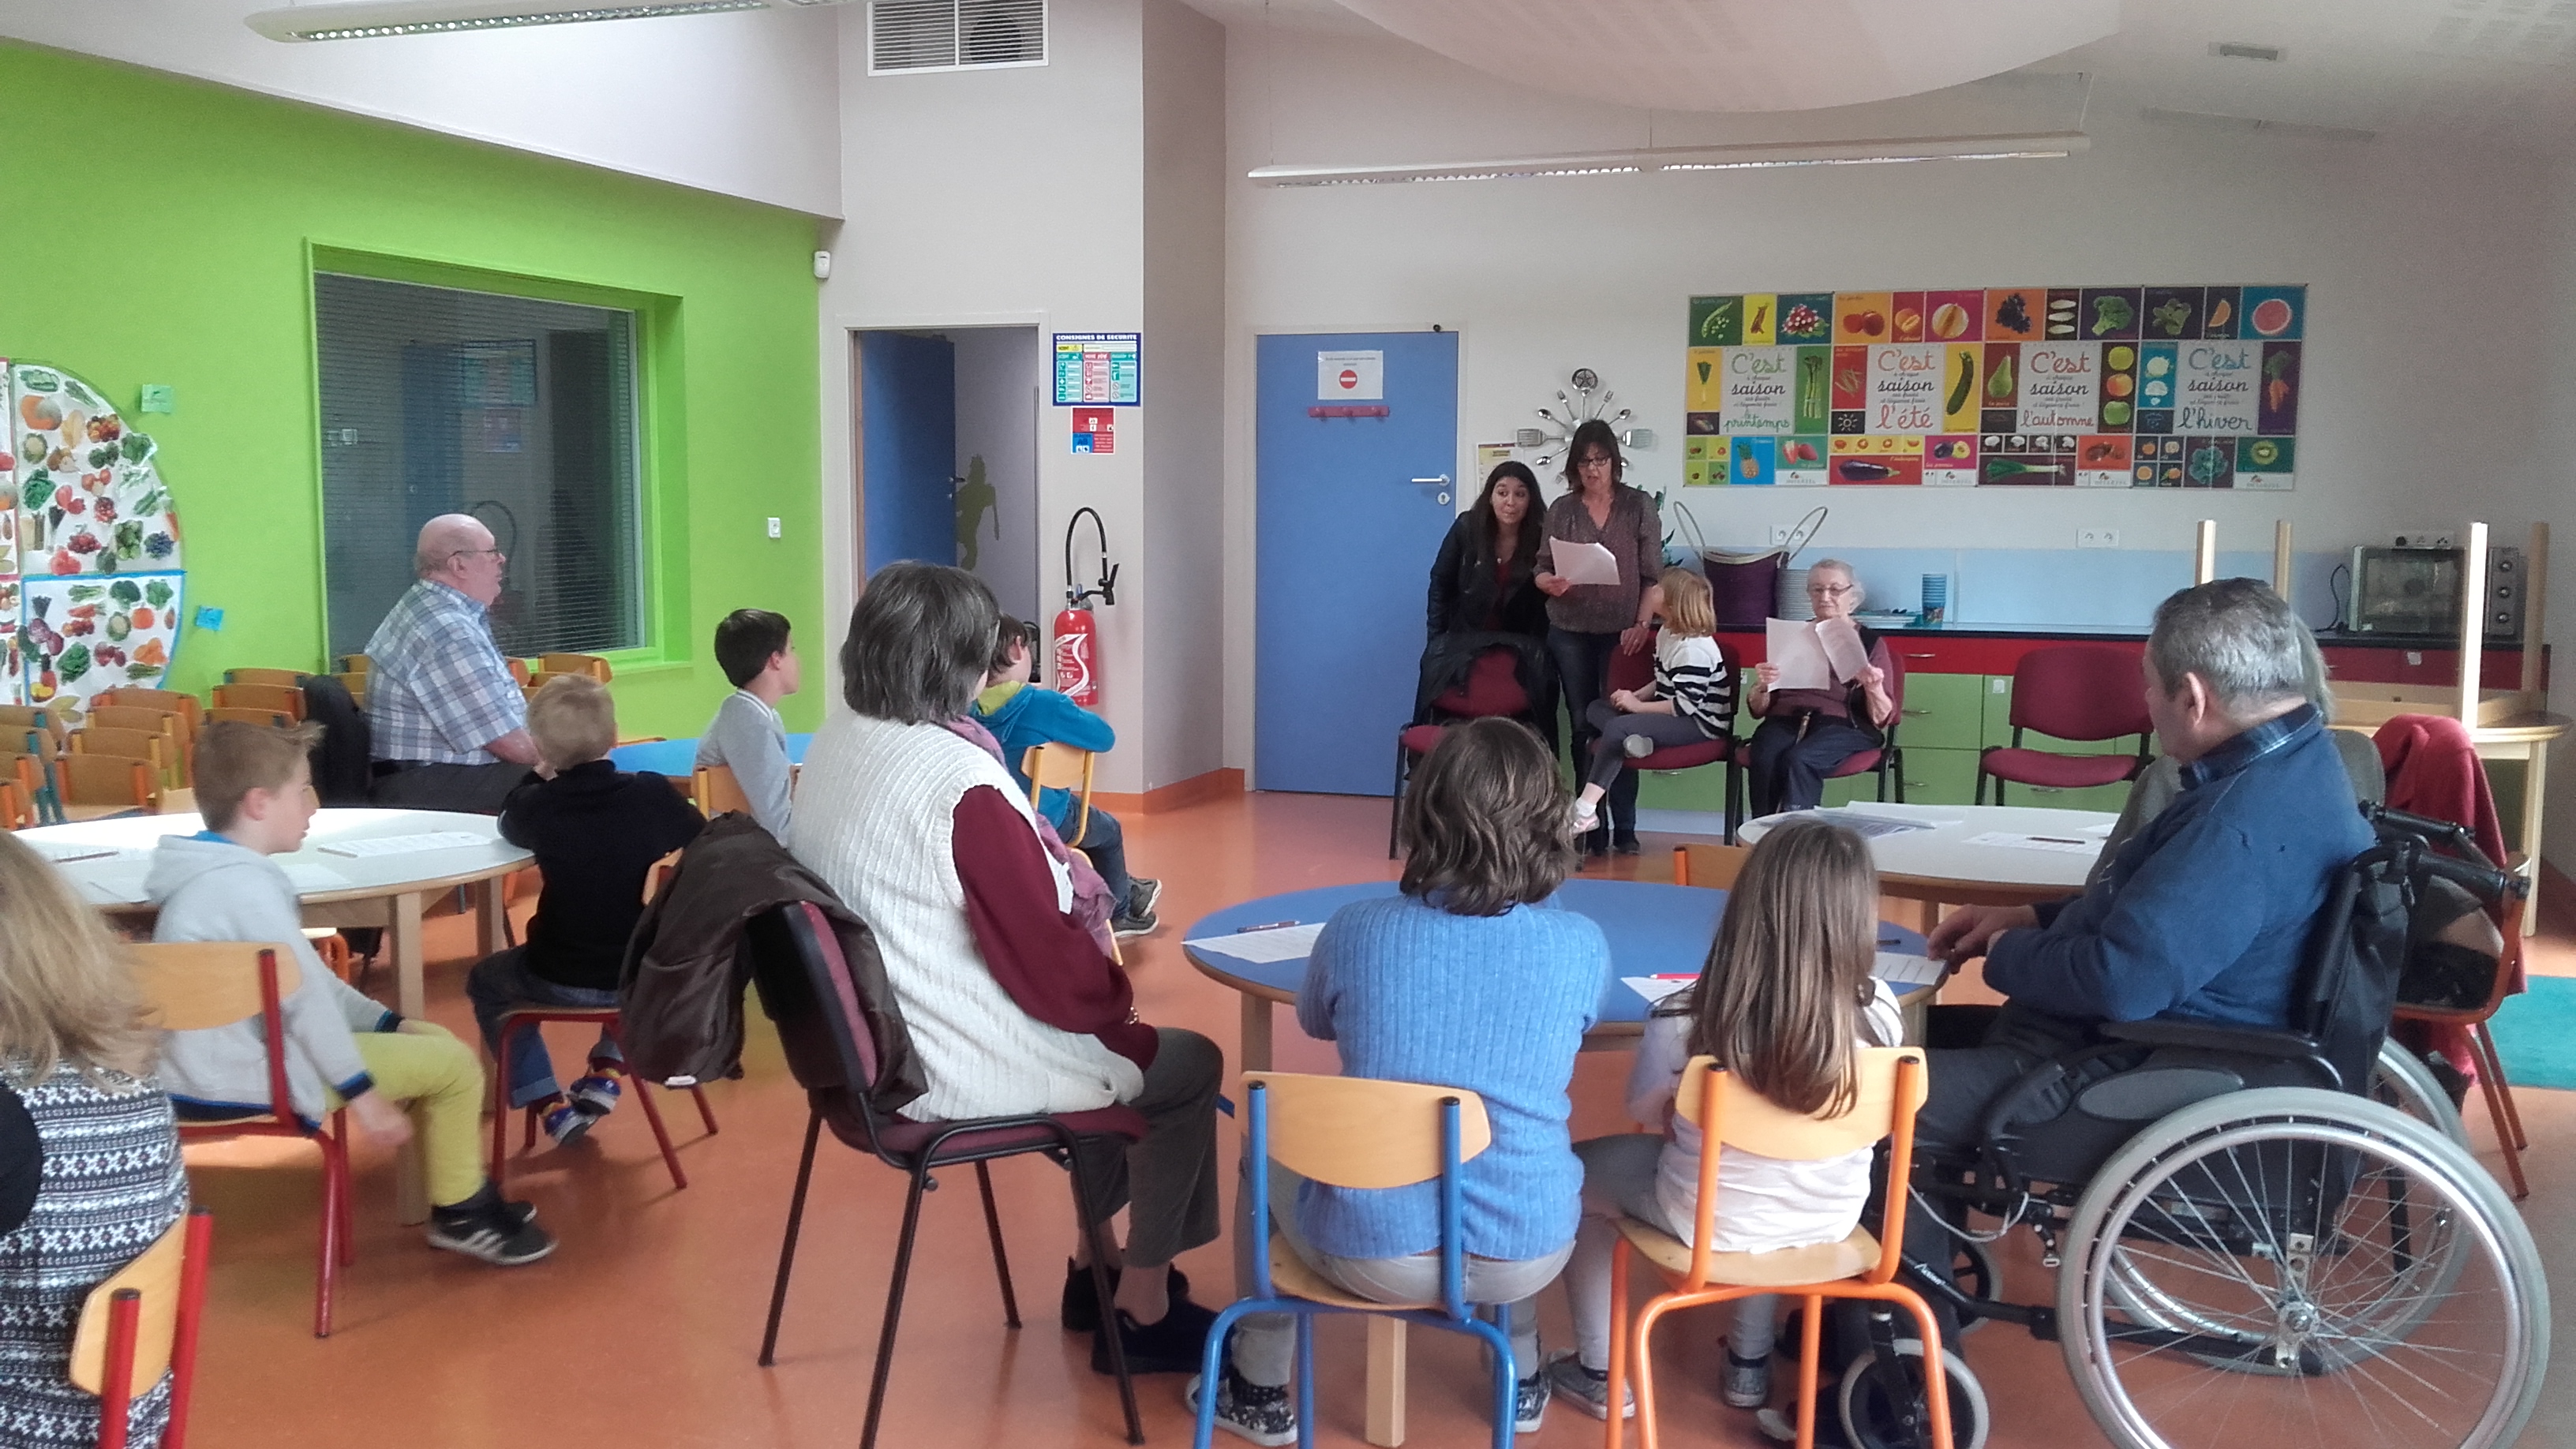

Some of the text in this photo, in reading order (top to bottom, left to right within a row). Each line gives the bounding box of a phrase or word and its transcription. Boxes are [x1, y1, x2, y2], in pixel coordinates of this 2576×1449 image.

[1732, 350, 1786, 375] C'est
[1878, 349, 1936, 373] C'est
[2030, 350, 2091, 374] C'est
[2188, 347, 2252, 371] C'est
[1732, 381, 1786, 395] saison
[1877, 376, 1934, 392] saison
[2030, 381, 2089, 395] saison
[2188, 377, 2249, 392] saison
[1723, 414, 1790, 432] printemps
[1875, 404, 1934, 429] l'été
[2020, 410, 2095, 427] l'automne
[2177, 406, 2252, 430] l'hiver
